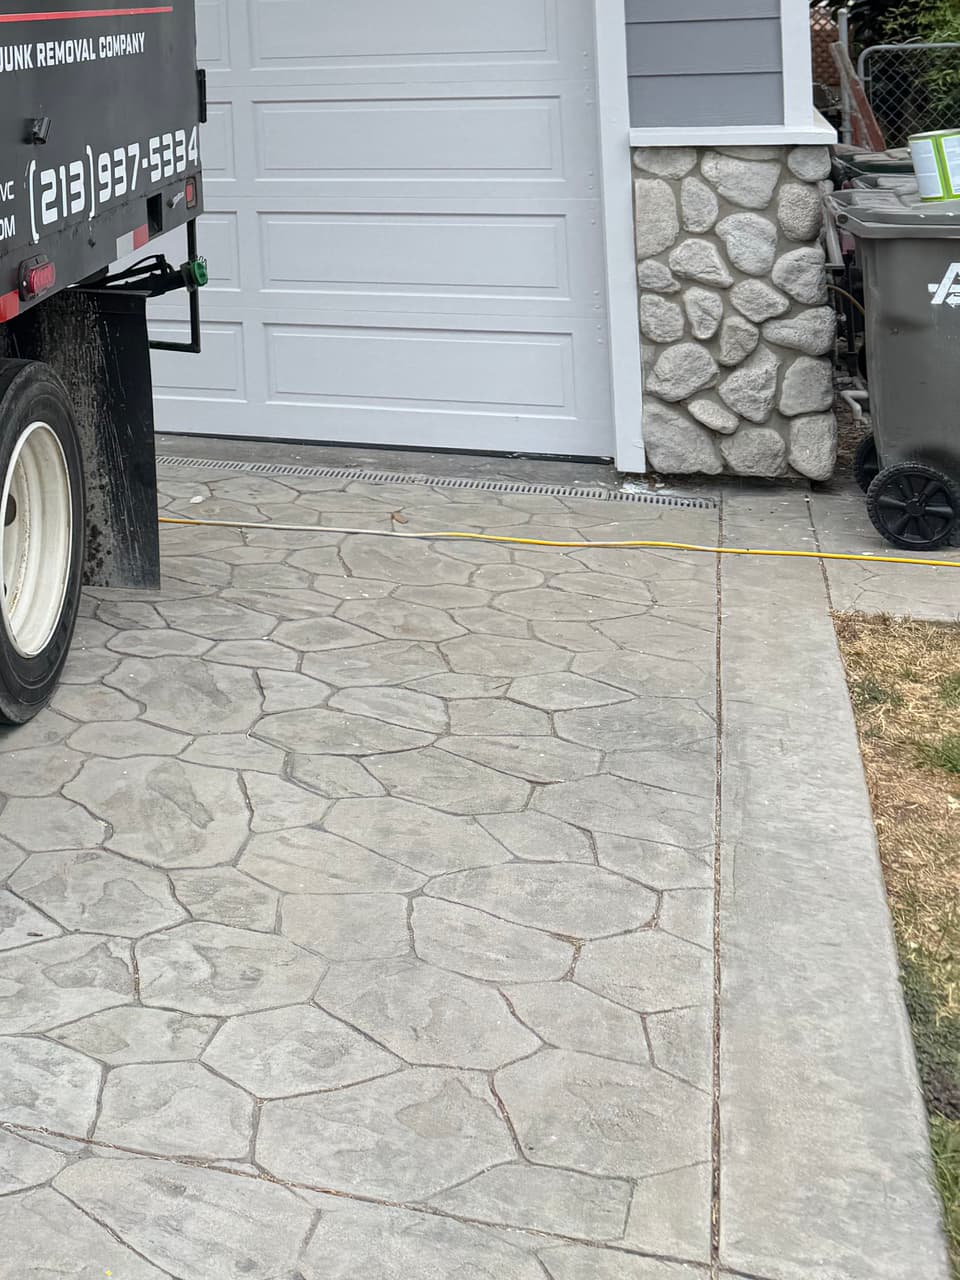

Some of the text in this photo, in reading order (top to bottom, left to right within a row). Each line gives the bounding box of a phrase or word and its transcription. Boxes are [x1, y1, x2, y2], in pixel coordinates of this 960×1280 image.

[36, 36, 97, 67] REMOVAL
[99, 32, 146, 59] COMPANY
[29, 125, 198, 244] (213)937-5334
